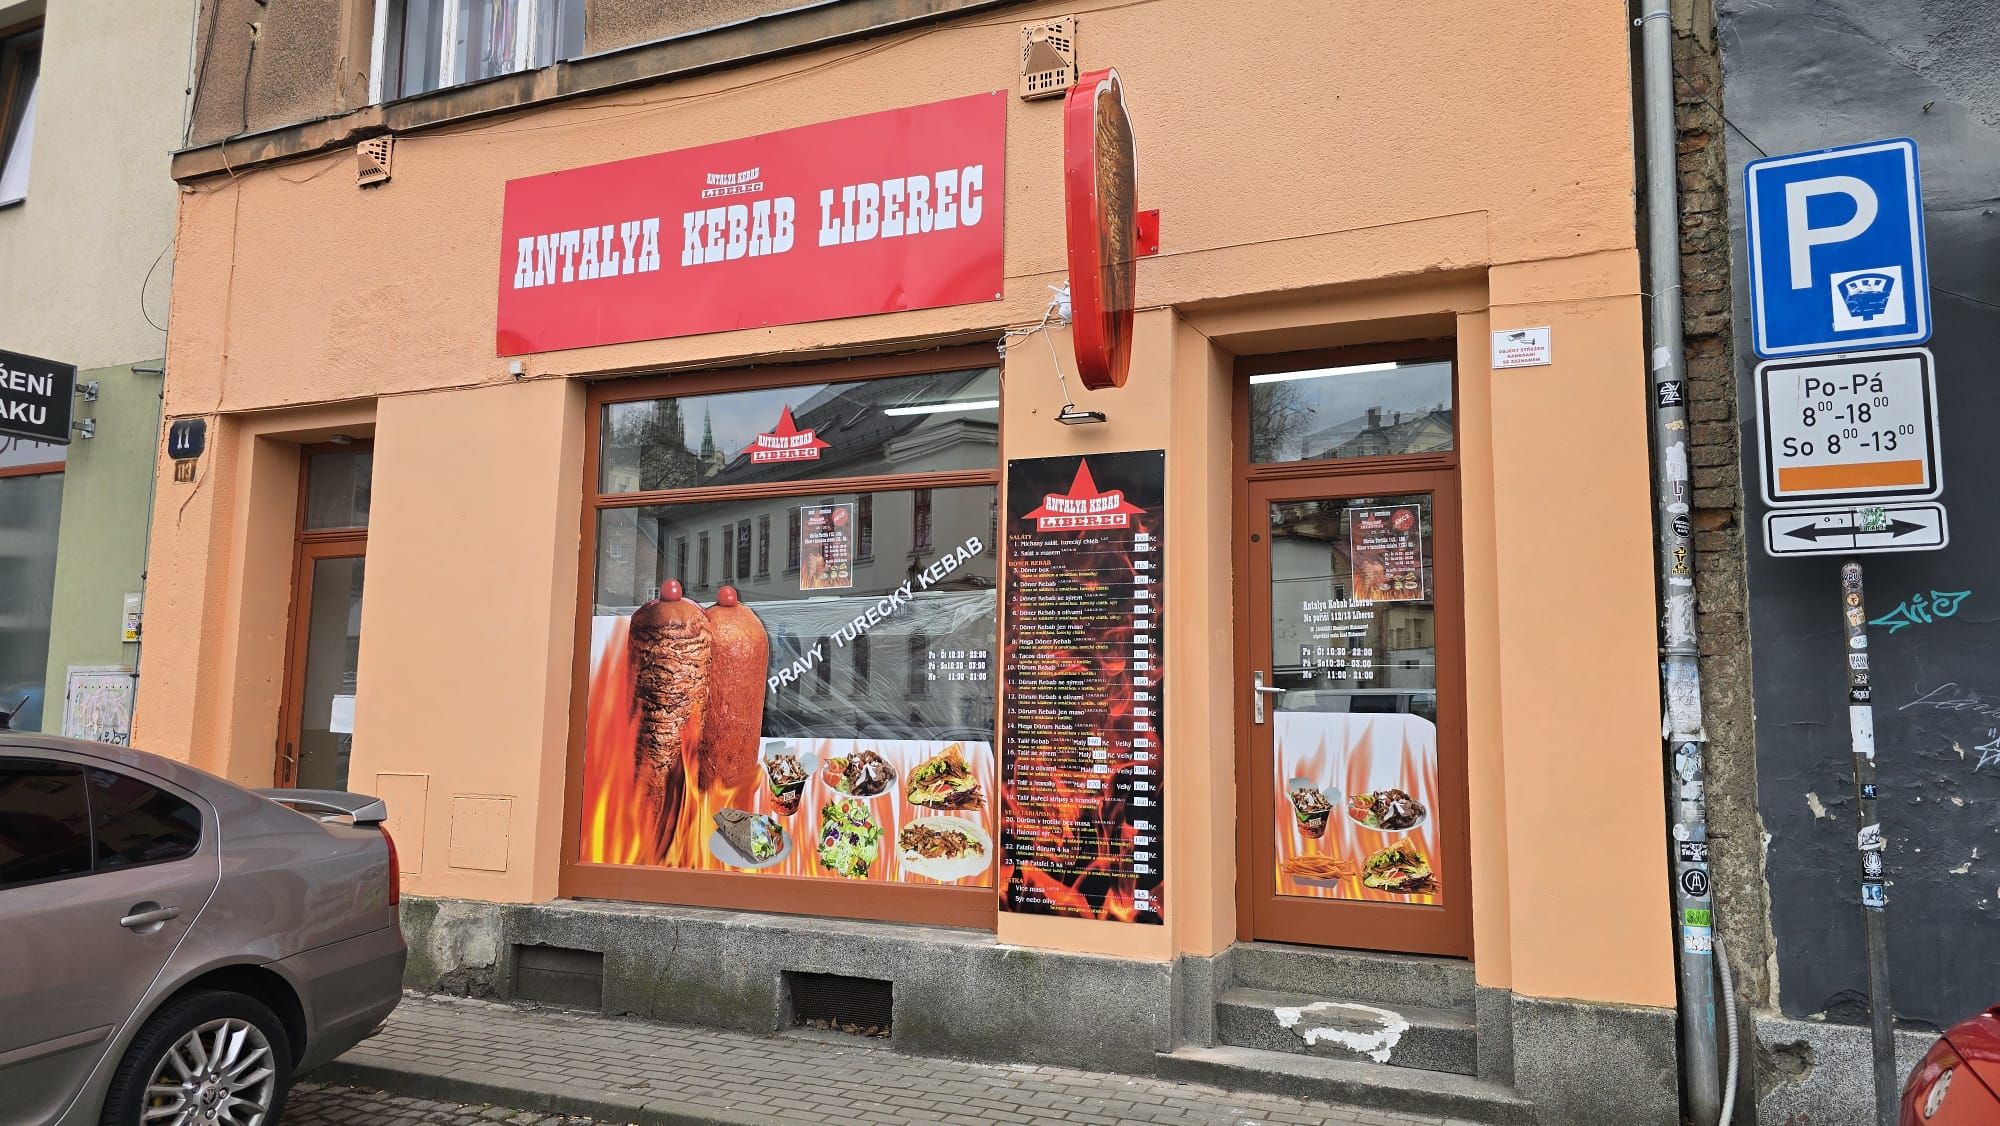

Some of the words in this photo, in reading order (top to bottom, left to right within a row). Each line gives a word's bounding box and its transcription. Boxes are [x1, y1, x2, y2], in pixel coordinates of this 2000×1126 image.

[706, 173, 736, 185] ANTALYA
[737, 167, 760, 184] KEBAB
[703, 183, 761, 198] LIBEREC
[513, 217, 660, 289] ANTALYA
[681, 196, 795, 267] KEBAB
[818, 164, 984, 247] LIBEREC
[1785, 175, 1879, 290] P
[1805, 372, 1883, 398] Po-Pá
[177, 426, 190, 449] 11
[758, 434, 789, 448] ANTALYA
[790, 431, 813, 448] KEBAB
[756, 448, 816, 460] LIBEREC
[1785, 437, 1816, 457] So
[1045, 497, 1087, 513] ANTALYA
[1089, 494, 1120, 512] KEBAB
[1042, 514, 1124, 528] LIBEREC
[767, 642, 825, 694] PRAVÝ
[830, 580, 914, 648] TURECKÝ
[918, 535, 985, 590] KEBAB
[1352, 647, 1373, 656] 22:00
[1327, 670, 1347, 680] 11:00
